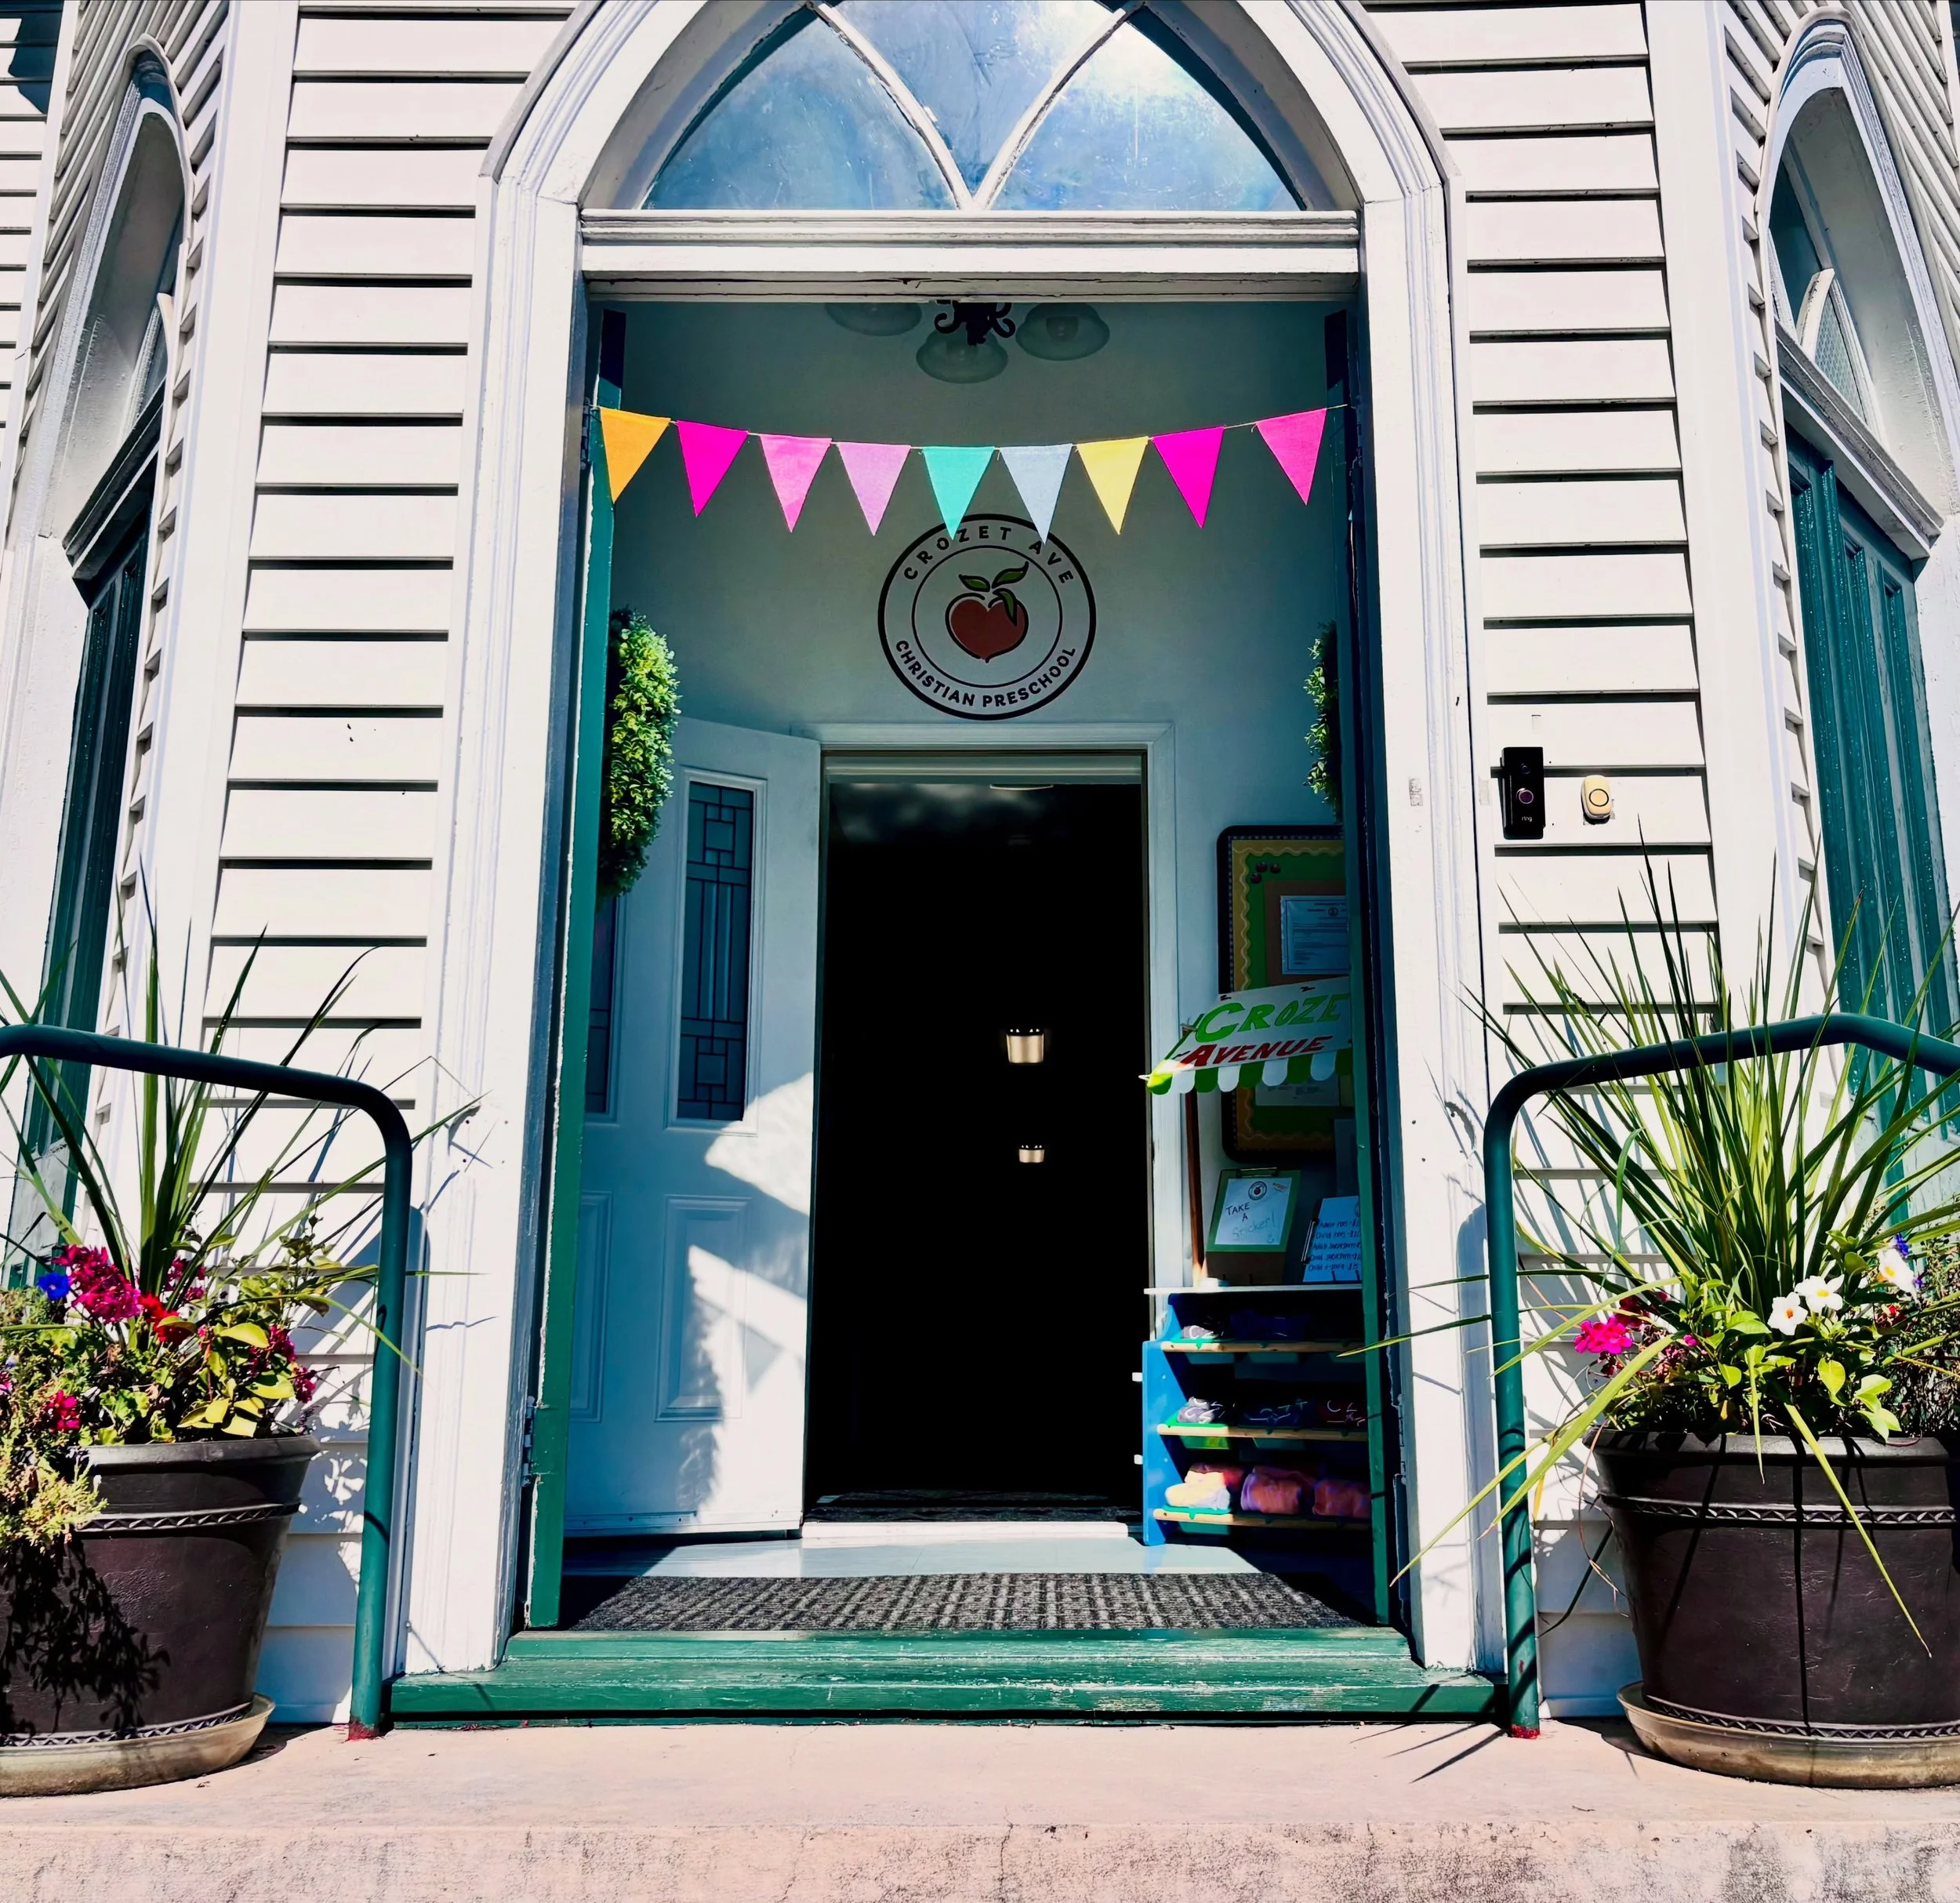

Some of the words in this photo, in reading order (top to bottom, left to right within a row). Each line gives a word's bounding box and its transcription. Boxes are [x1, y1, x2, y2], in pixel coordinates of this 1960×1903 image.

[904, 525, 1011, 580] CROZET
[1029, 540, 1074, 584] AVE
[895, 640, 975, 706] CHRISTIAN
[982, 648, 1076, 707] PRESCHOOL
[1176, 1035, 1333, 1067] AVENUE
[1225, 1201, 1250, 1216] TAKE
[1242, 1213, 1249, 1222] A
